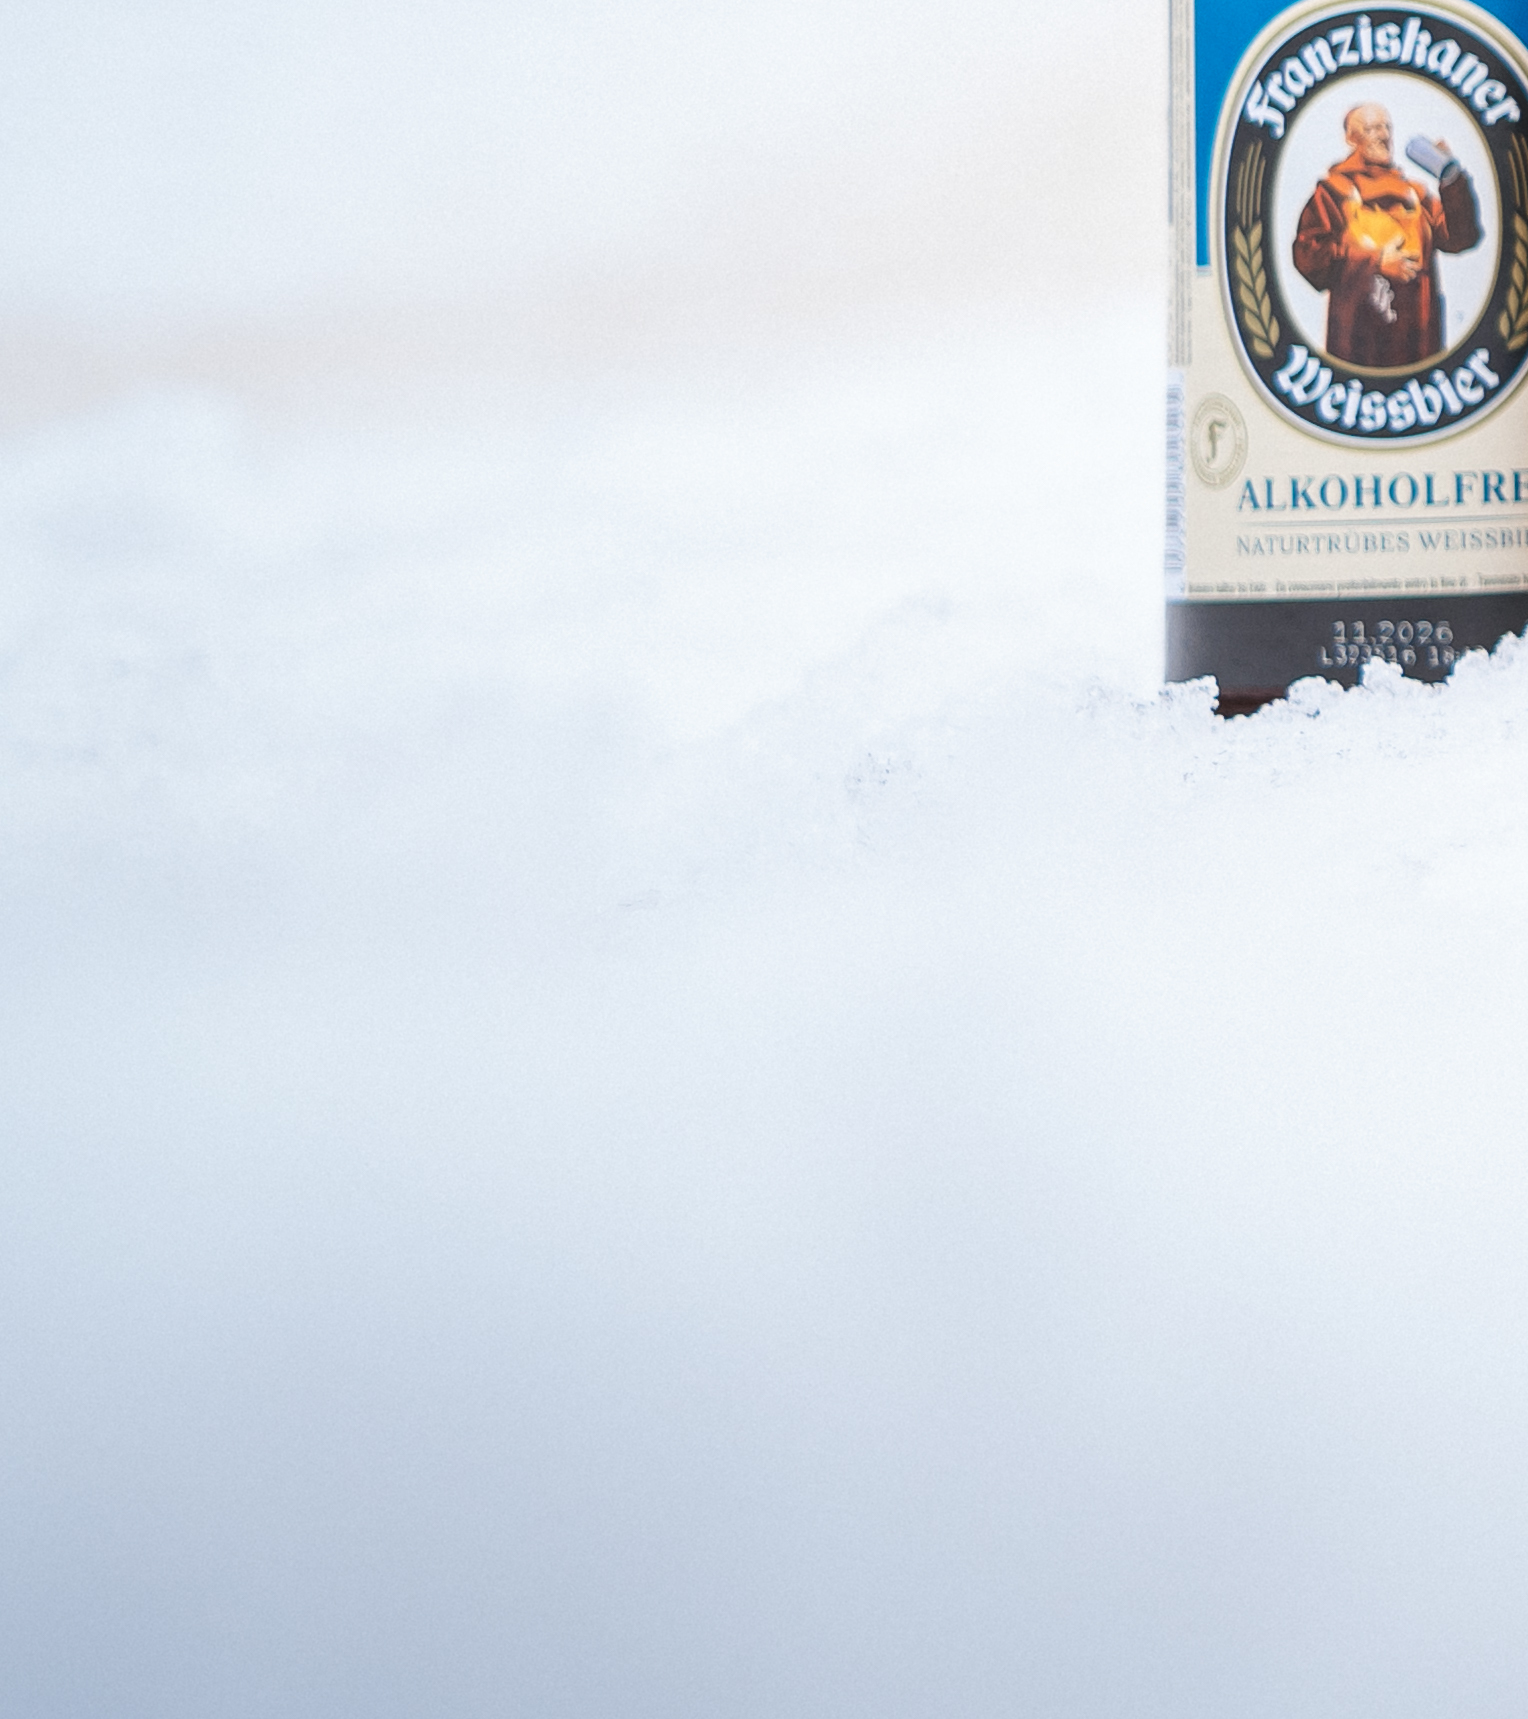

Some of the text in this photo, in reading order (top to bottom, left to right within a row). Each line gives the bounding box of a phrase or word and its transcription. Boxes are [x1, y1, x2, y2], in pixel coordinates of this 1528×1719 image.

[1244, 13, 1521, 140] Franziskaner
[1271, 343, 1501, 435] Weissbier
[1236, 527, 1410, 557] NATURTRÜBES
[1332, 621, 1454, 646] 11.2026
